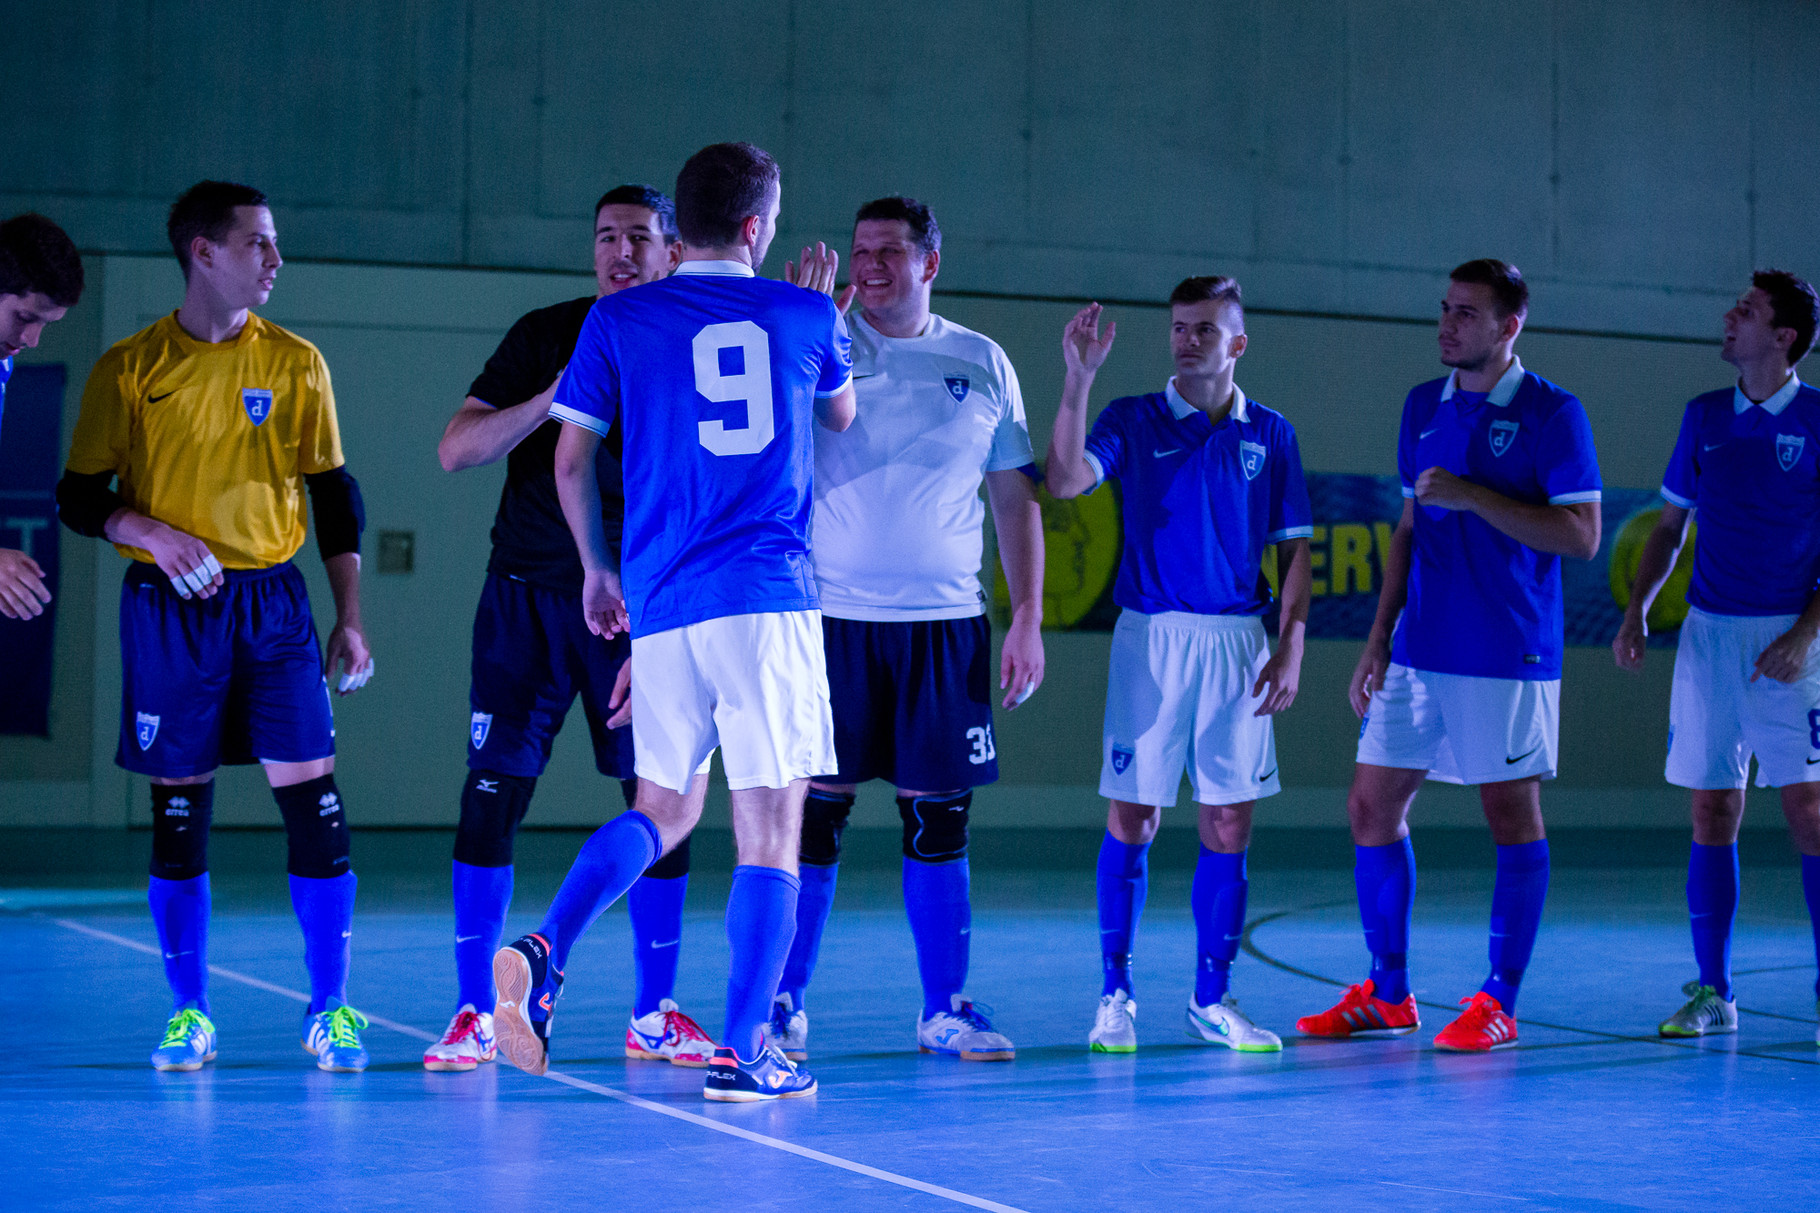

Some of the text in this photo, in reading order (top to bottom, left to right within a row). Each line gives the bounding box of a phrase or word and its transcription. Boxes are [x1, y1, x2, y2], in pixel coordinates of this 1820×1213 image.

[692, 320, 775, 457] 9
[952, 380, 964, 394] d
[251, 400, 263, 416] d
[1247, 454, 1257, 470] d
[140, 726, 149, 741] d
[474, 725, 483, 740] d
[1114, 754, 1125, 769] d
